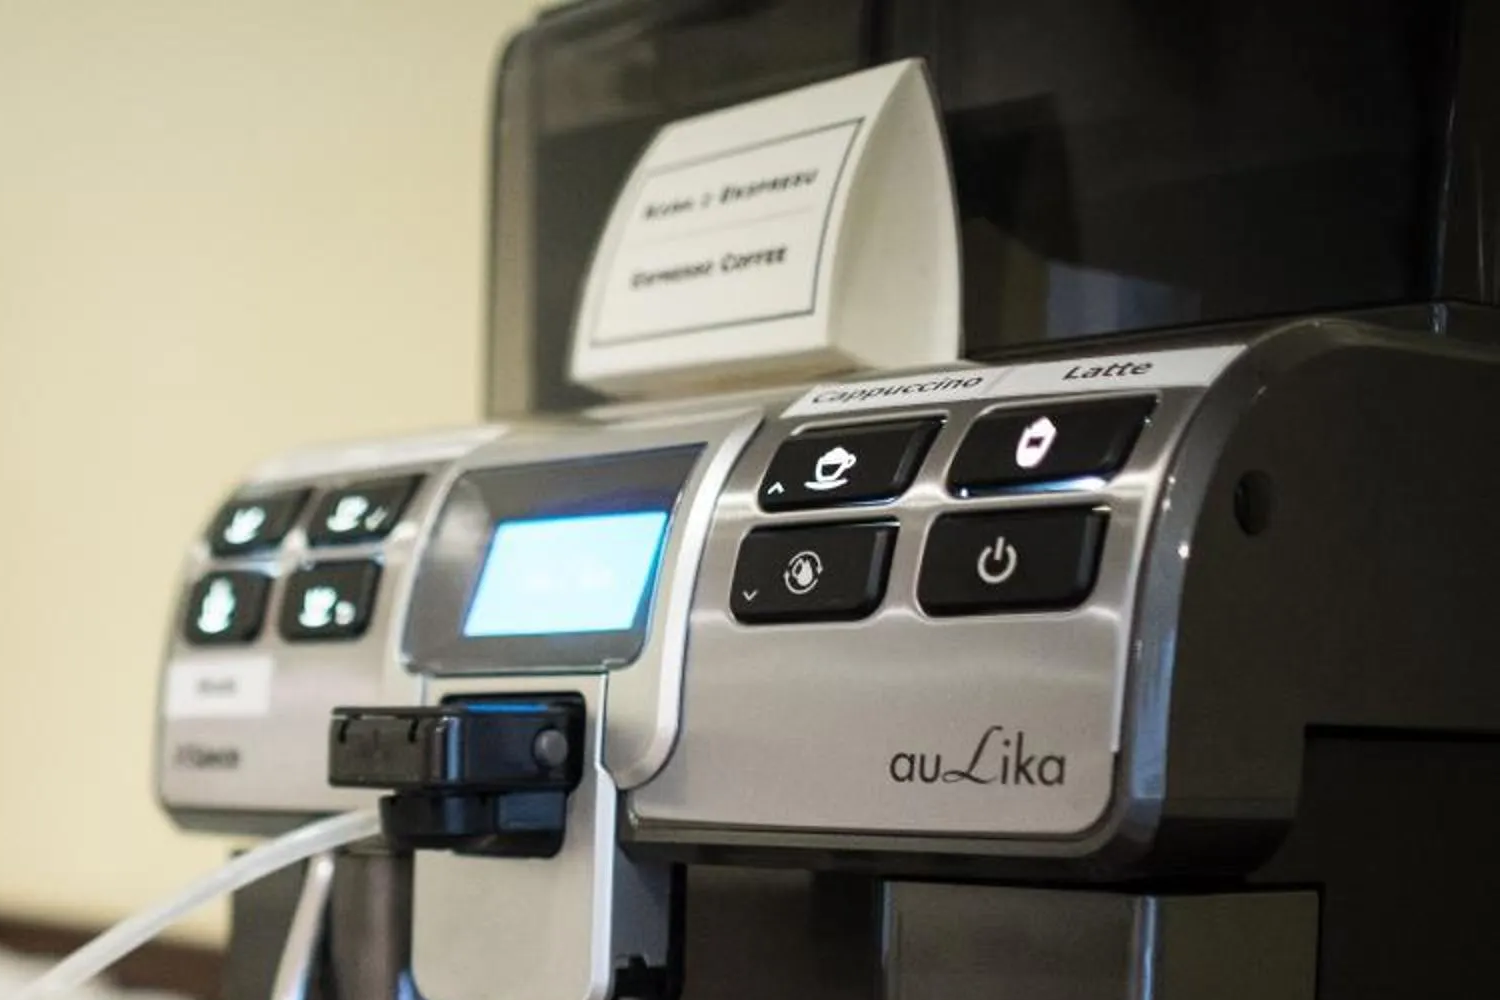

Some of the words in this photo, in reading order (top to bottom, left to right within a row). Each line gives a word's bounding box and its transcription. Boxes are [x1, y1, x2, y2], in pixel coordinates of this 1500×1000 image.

[1062, 359, 1154, 381] Latte
[811, 375, 984, 404] Cappuccino
[889, 725, 1066, 787] auLika
